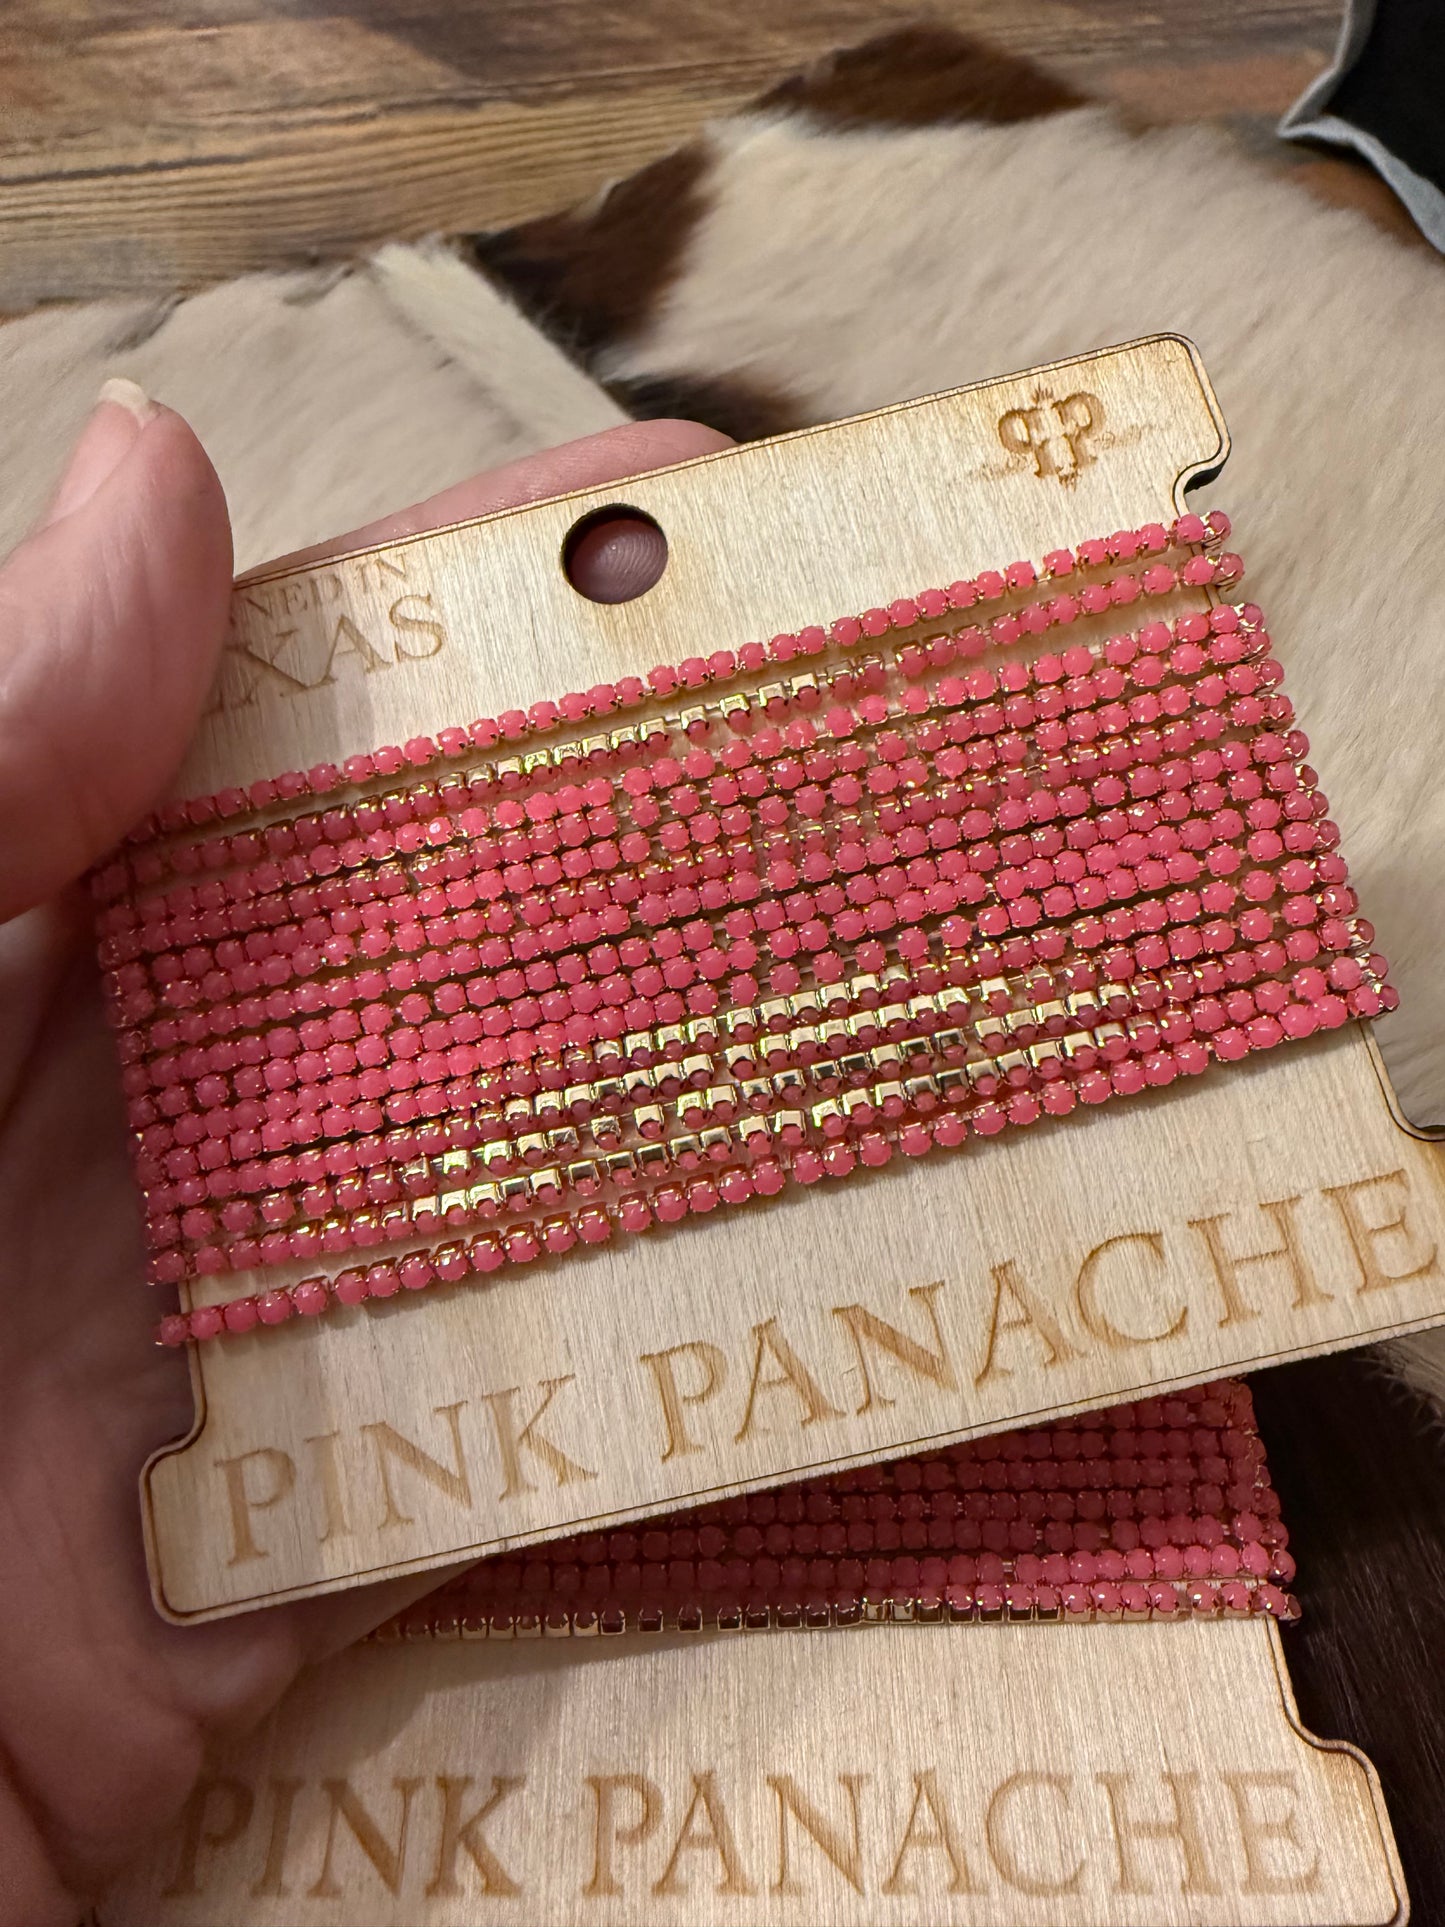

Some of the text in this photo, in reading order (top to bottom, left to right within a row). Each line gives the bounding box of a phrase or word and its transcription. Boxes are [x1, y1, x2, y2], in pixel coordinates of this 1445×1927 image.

[200, 592, 444, 717] XAS
[213, 1168, 1439, 1568] PINK PANACHE
[161, 1769, 1323, 1899] PINK PANACHE
